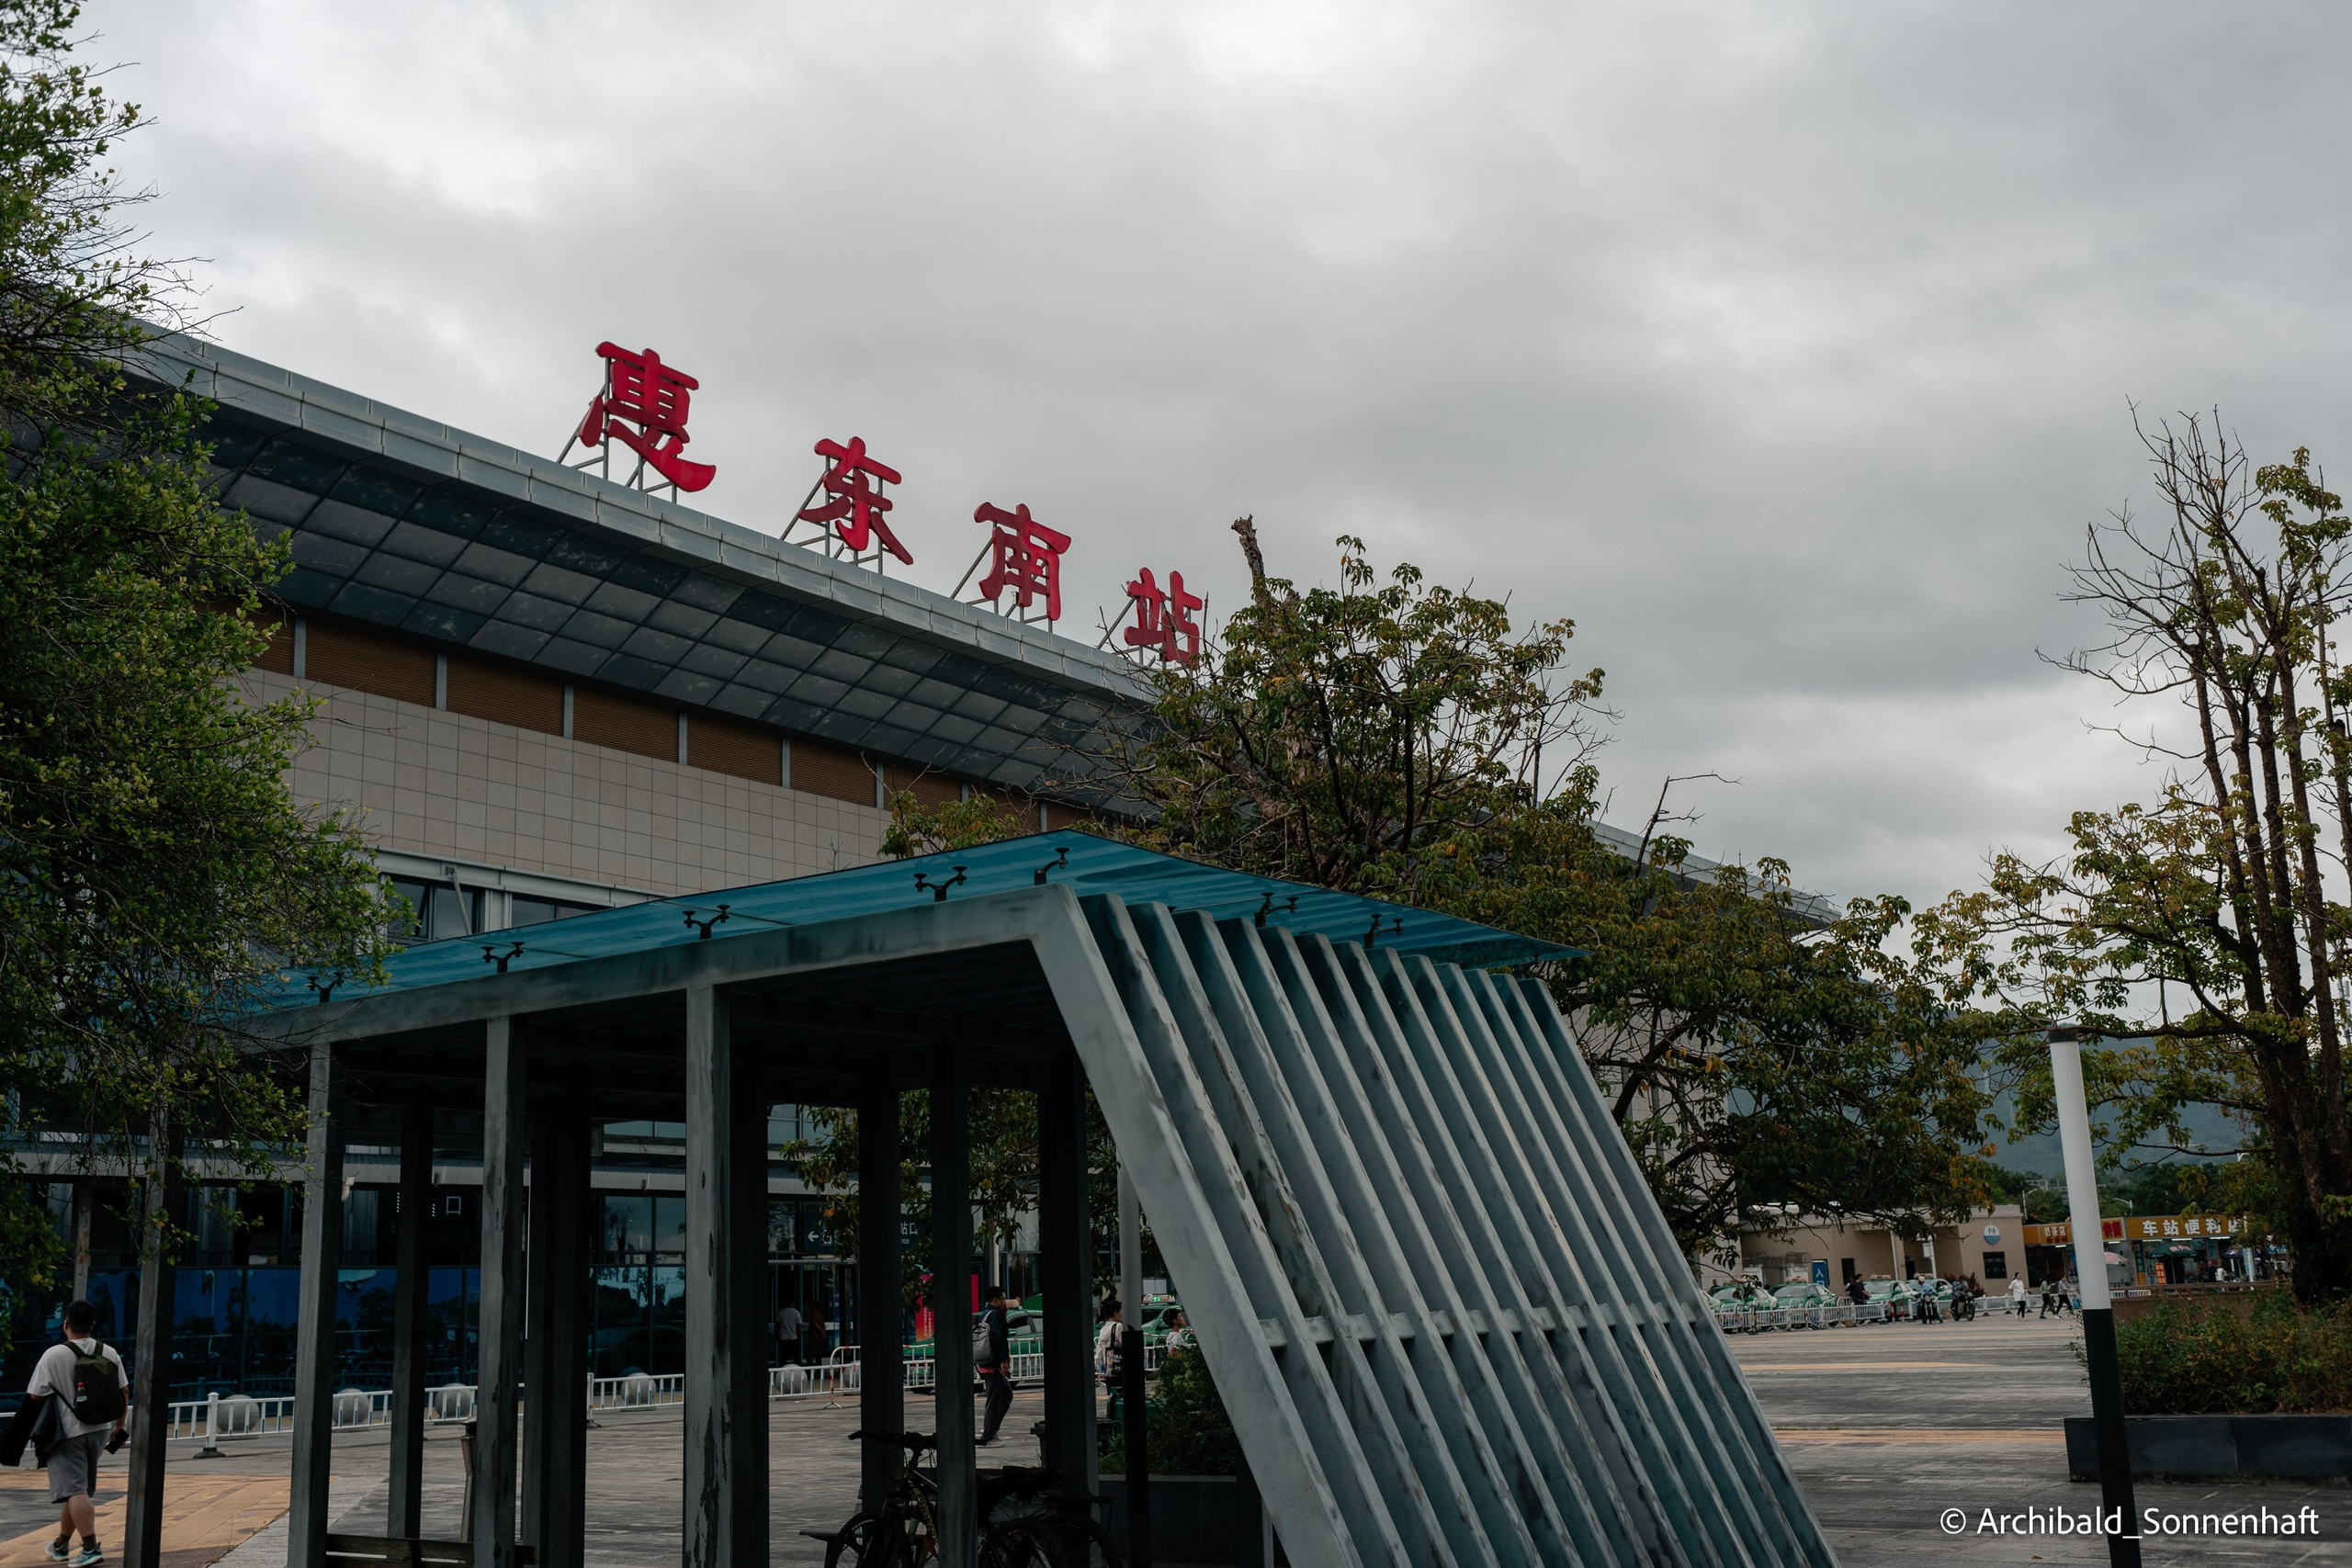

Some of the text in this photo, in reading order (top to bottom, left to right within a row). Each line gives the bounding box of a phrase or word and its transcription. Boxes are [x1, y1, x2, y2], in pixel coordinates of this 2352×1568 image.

[578, 340, 1203, 670] 惠东南站
[900, 1221, 918, 1235] 站口
[2043, 1224, 2066, 1237] 奶茶店
